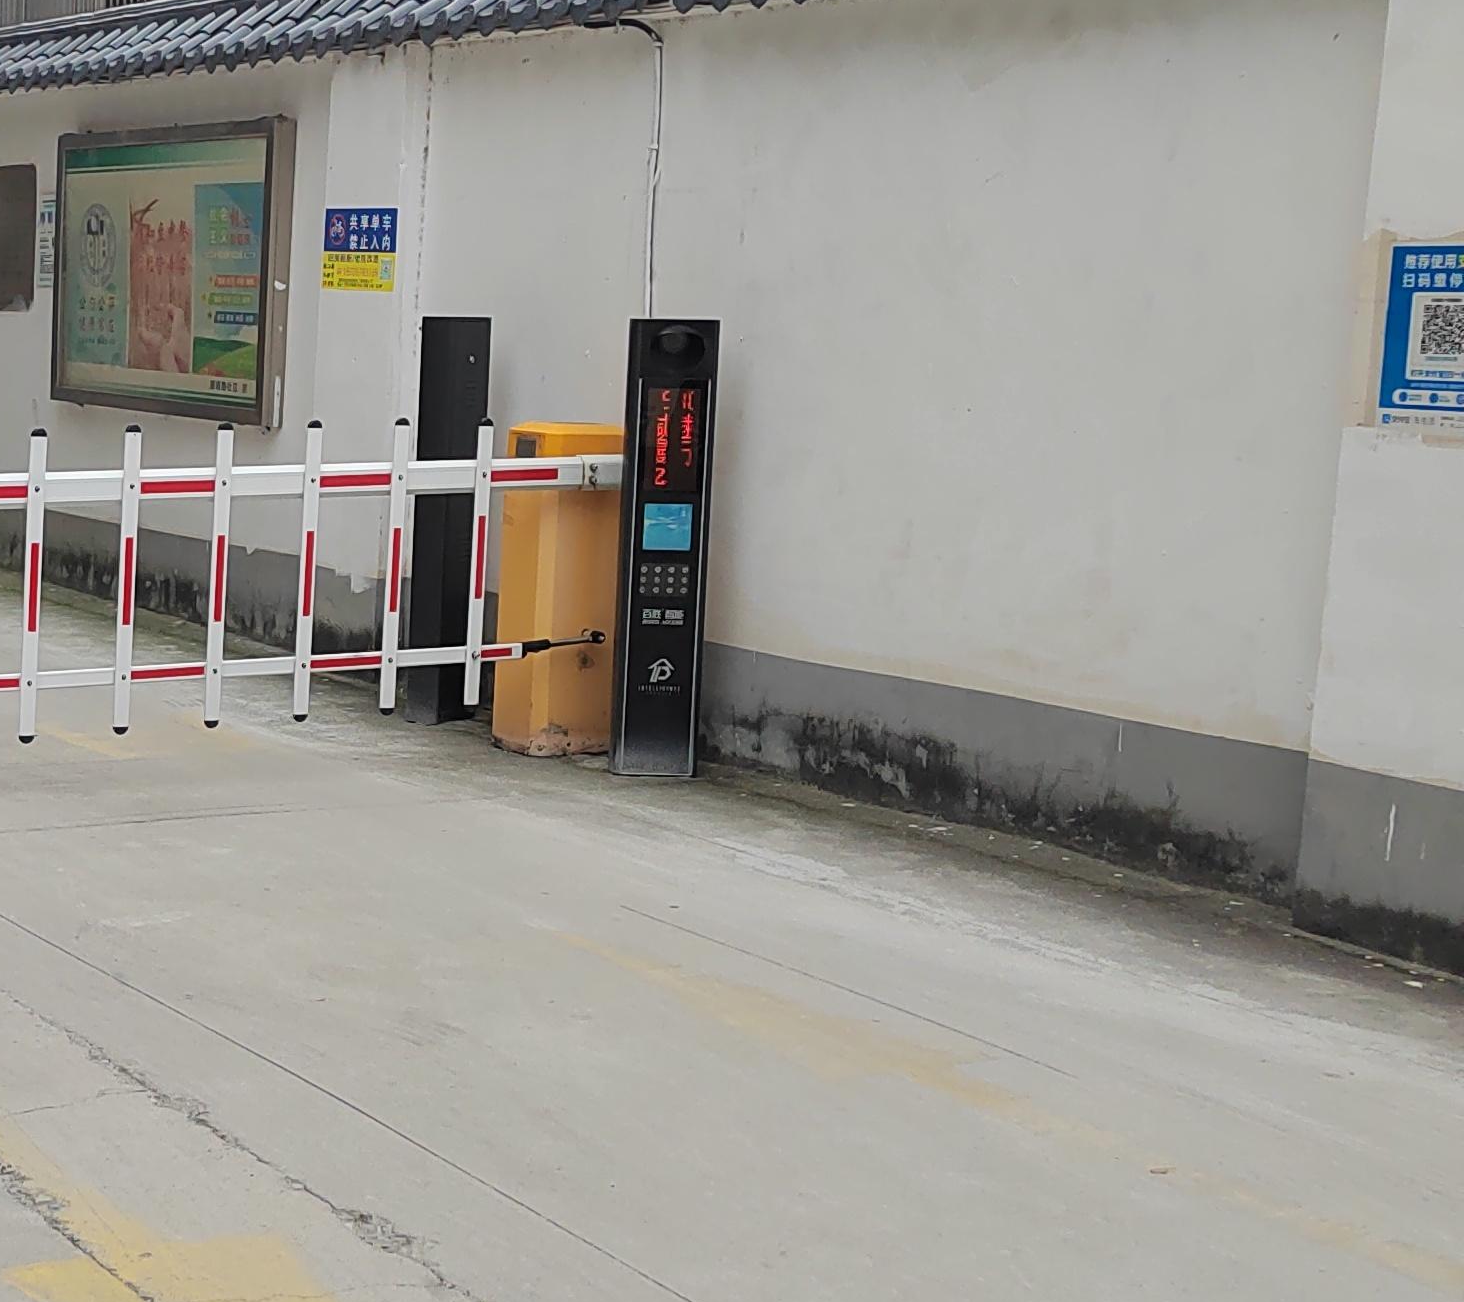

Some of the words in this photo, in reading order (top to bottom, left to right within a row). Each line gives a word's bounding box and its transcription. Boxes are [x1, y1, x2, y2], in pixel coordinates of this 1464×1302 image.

[349, 213, 392, 231] 共享单车
[349, 234, 391, 251] 禁止入内
